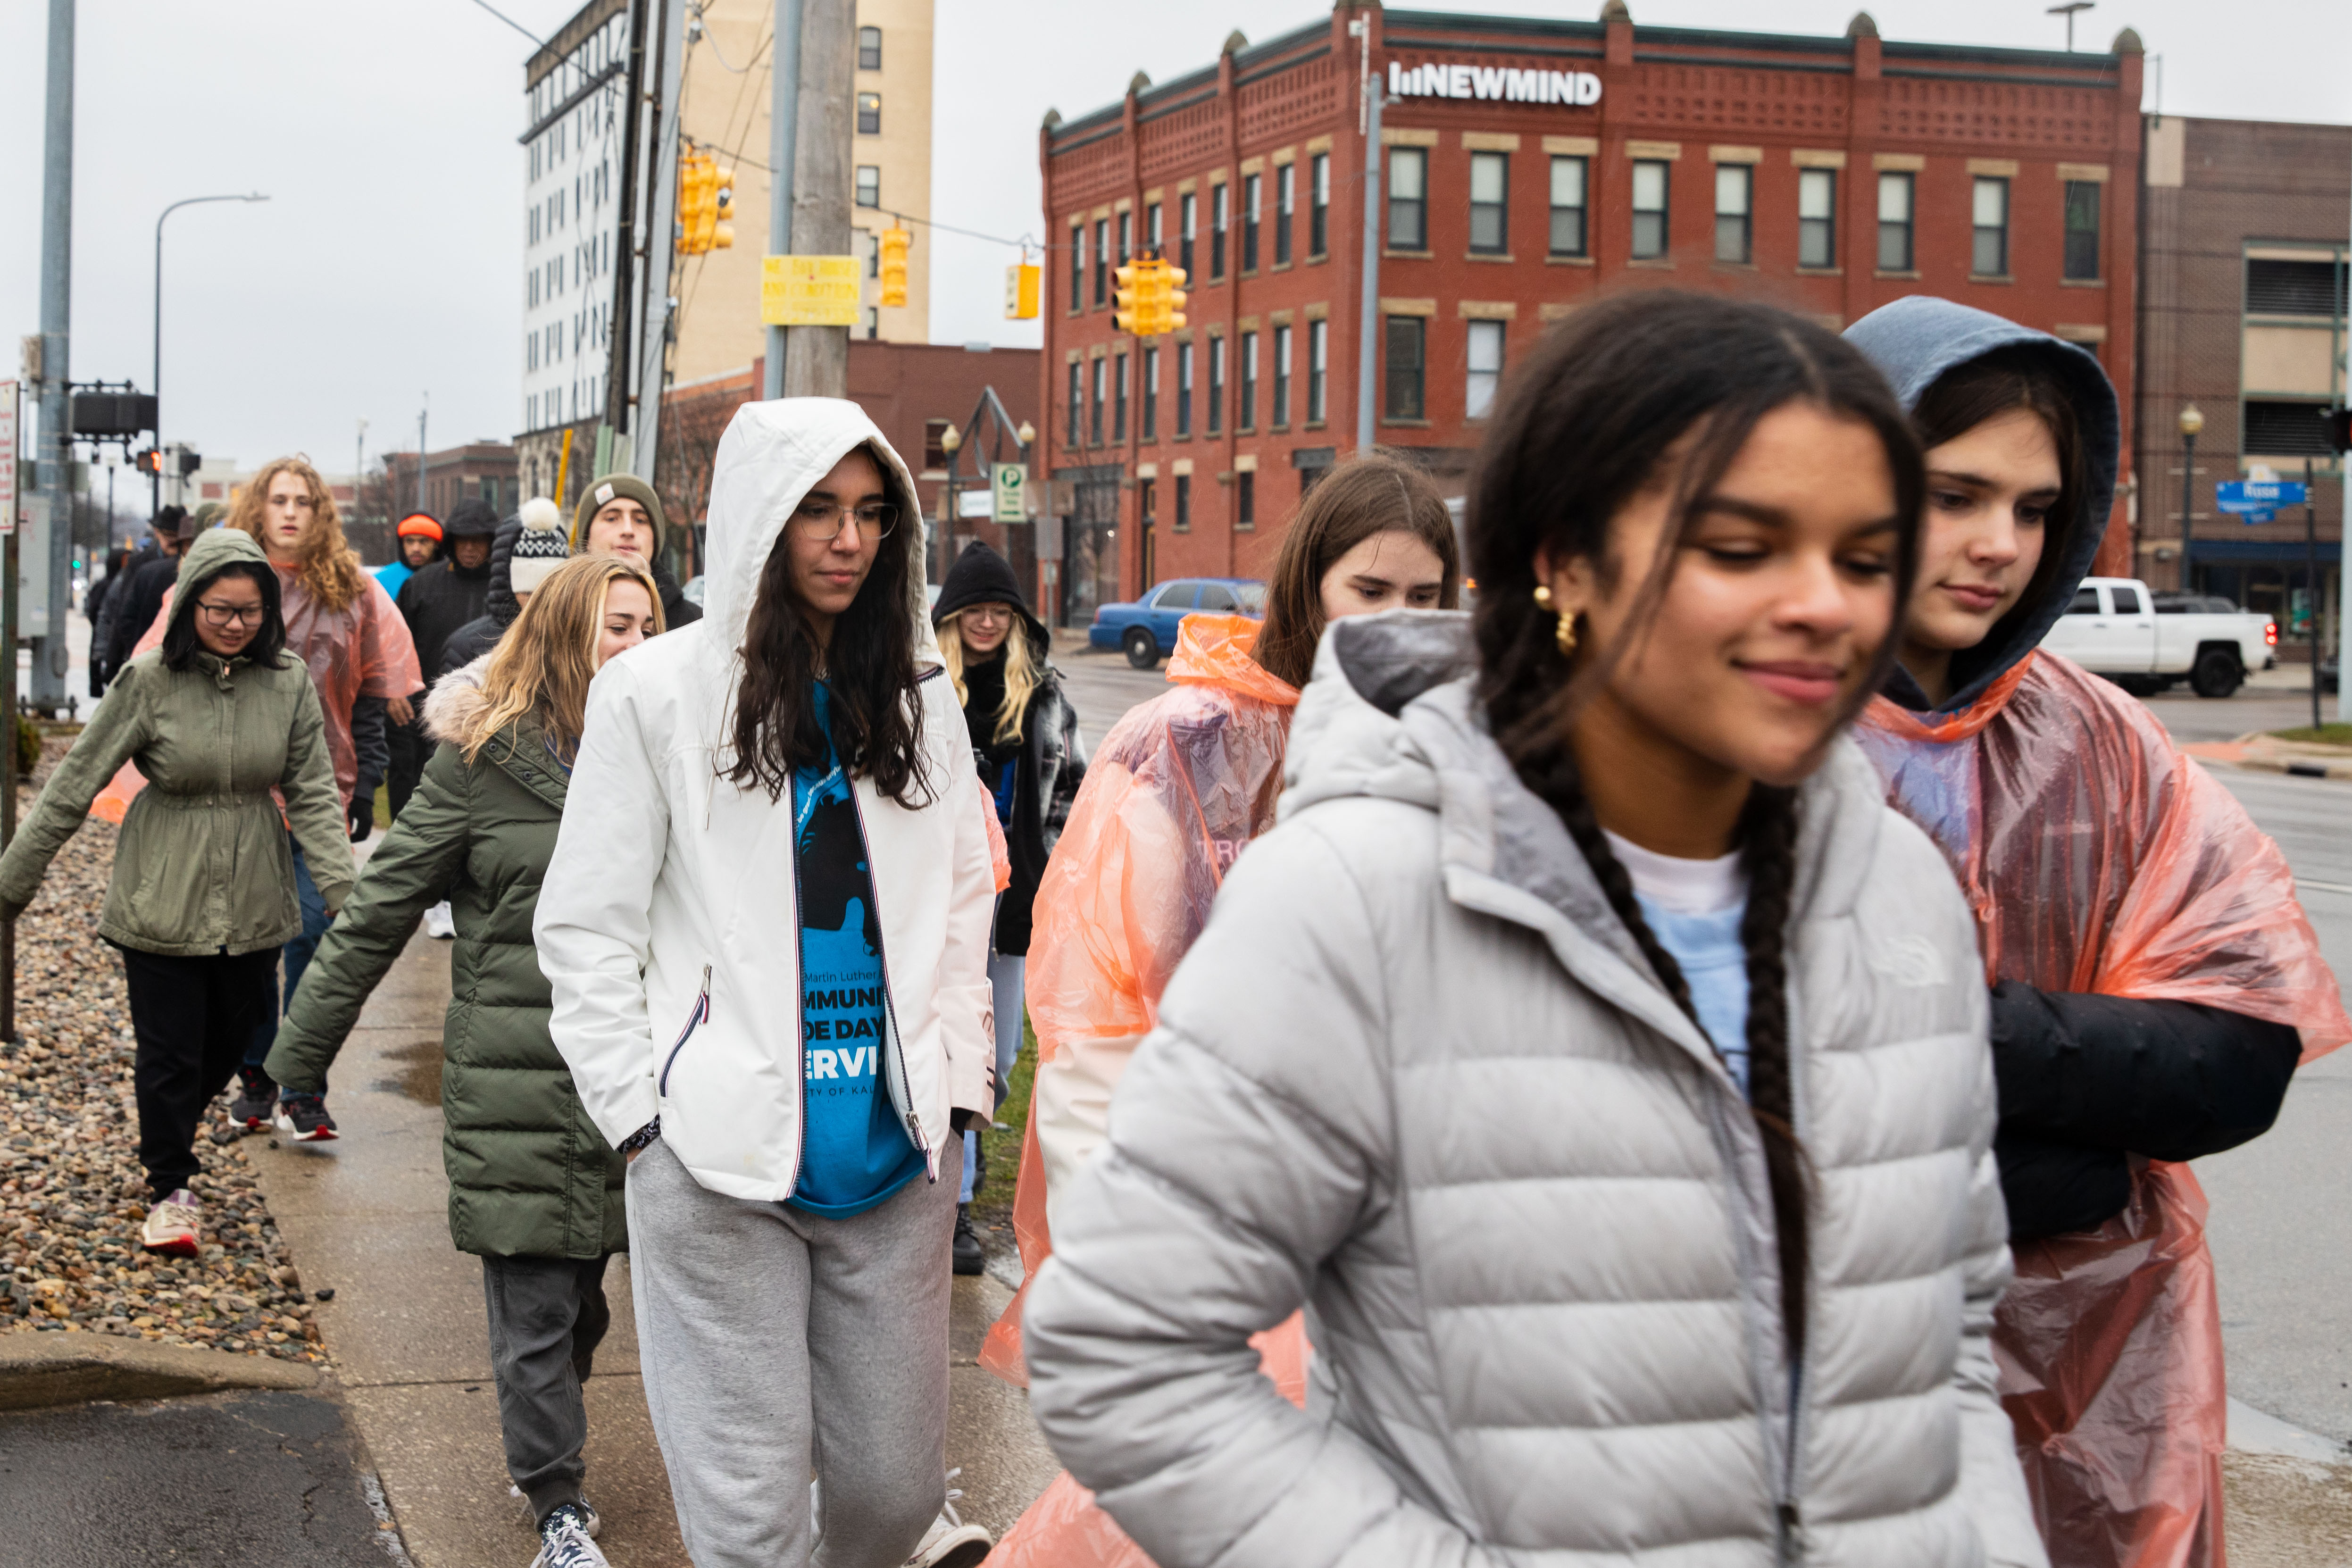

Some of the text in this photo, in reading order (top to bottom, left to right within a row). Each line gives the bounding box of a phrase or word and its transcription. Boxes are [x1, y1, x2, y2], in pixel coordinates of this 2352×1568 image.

[1422, 63, 1602, 106] NEWMIND
[805, 971, 836, 983] Martin
[841, 970, 876, 982] Luther
[835, 1016, 883, 1040] DAY
[829, 1087, 844, 1096] OF
